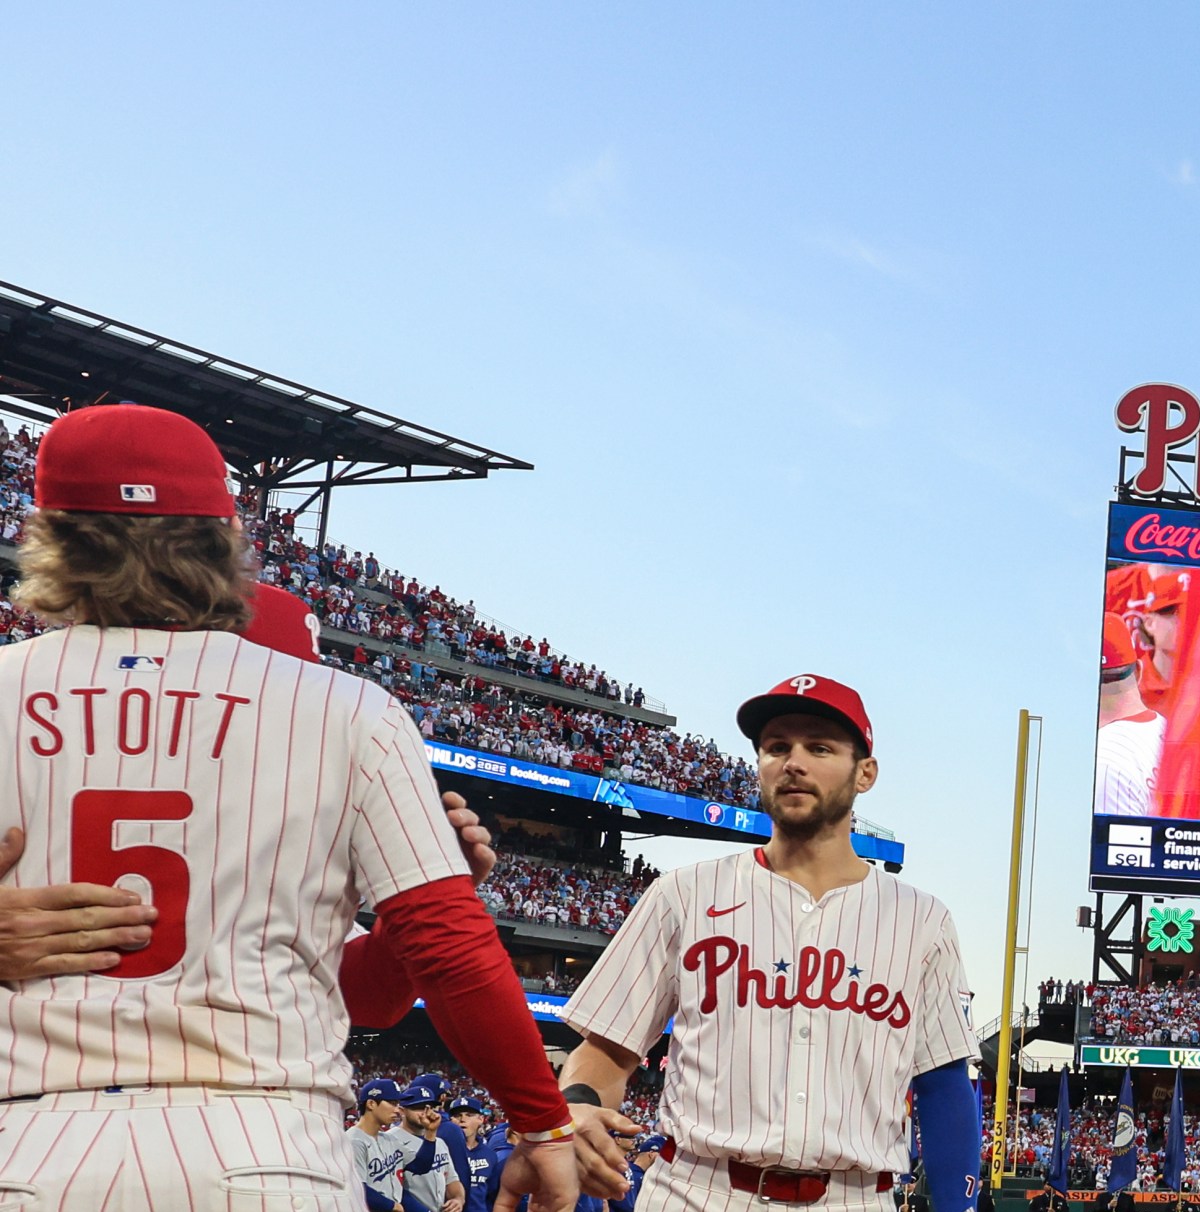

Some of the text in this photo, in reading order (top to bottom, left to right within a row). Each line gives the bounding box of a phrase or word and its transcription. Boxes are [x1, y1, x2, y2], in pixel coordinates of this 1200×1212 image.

[24, 687, 251, 759] STOTT
[433, 750, 507, 774] NLDS 2025
[510, 766, 571, 788] Booking.com
[70, 789, 194, 979] 5
[683, 935, 911, 1029] Phillies
[1100, 1048, 1140, 1065] UKG
[993, 1121, 1004, 1175] 329
[965, 1175, 976, 1198] 7
